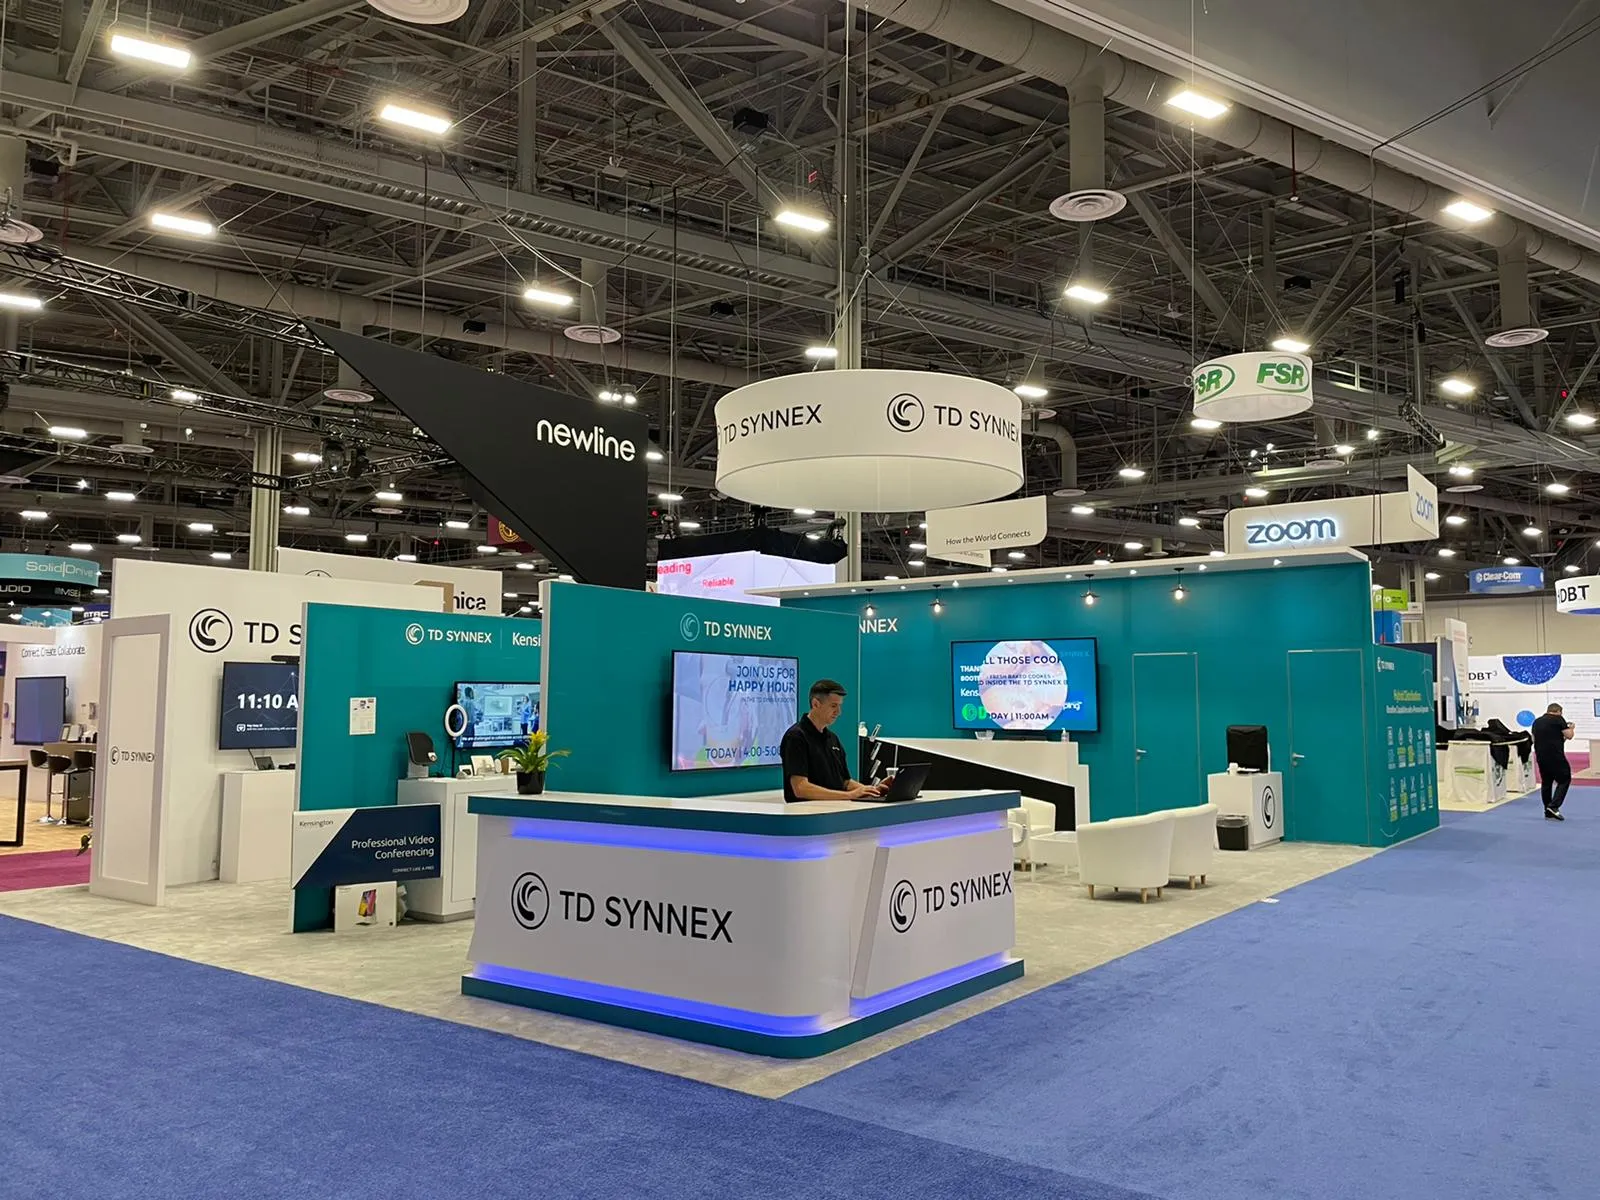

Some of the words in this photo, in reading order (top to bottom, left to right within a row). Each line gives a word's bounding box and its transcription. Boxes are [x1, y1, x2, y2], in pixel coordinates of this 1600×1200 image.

[1256, 363, 1304, 386] FSR
[934, 405, 962, 426] TD
[723, 423, 737, 444] TD
[741, 404, 822, 437] SYNNEX
[537, 419, 636, 462] newline
[946, 538, 962, 546] How
[963, 536, 974, 544] the
[974, 533, 997, 542] World
[997, 530, 1031, 540] Connects
[1246, 518, 1336, 544] zoom
[703, 577, 735, 587] Reliable
[1558, 585, 1589, 603] DBT
[244, 622, 279, 644] TD
[428, 629, 443, 641] TD
[446, 630, 492, 644] SYNNEX
[704, 621, 720, 637] TD
[724, 623, 772, 641] SYNNEX
[997, 656, 1031, 664] THOSE
[736, 666, 759, 677] JOIN
[761, 666, 774, 679] US
[776, 667, 795, 679] FOR
[729, 680, 764, 692] HAPPY
[767, 681, 795, 693] HOUR
[238, 694, 283, 709] 11:10
[1015, 712, 1049, 720] 11:00AM
[121, 751, 130, 762] TD
[705, 748, 737, 759] TODAY
[352, 836, 407, 849] Professional
[409, 835, 435, 845] Video
[375, 848, 435, 860] Conferencing
[923, 886, 945, 913] TD
[950, 870, 1012, 907] SYNNEX
[560, 890, 595, 922] TD
[605, 896, 733, 944] SYNNEX
